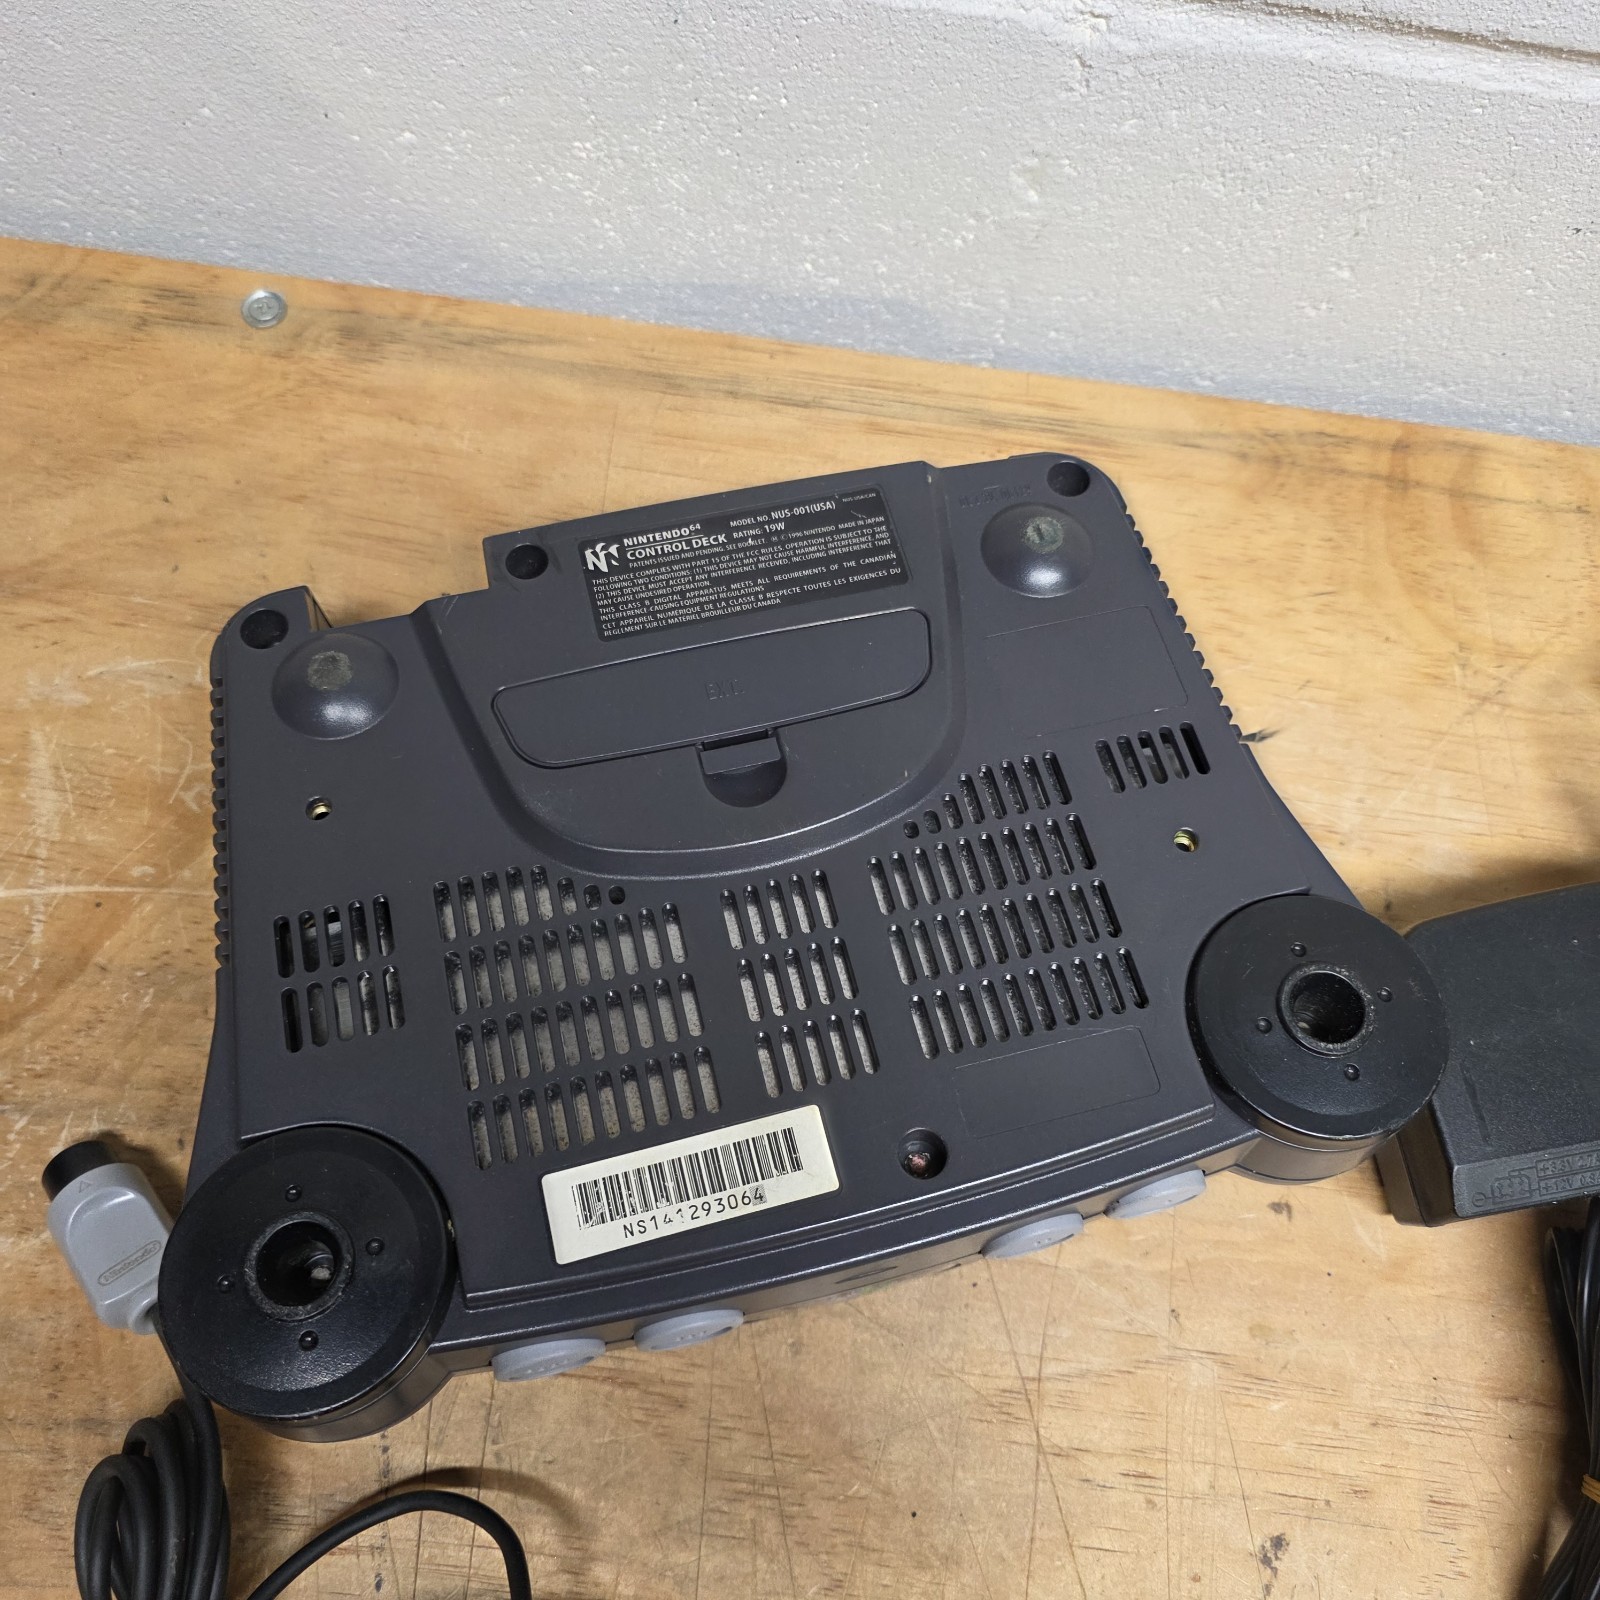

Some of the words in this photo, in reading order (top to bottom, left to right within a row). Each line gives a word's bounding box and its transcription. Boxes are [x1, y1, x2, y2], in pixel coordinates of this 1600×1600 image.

[729, 517, 755, 527] MODEL
[756, 514, 770, 522] NO.
[771, 500, 836, 520] NUS-001(USA)
[732, 527, 763, 538] RATING:
[764, 521, 785, 532] 19W
[592, 577, 608, 585] THIS
[609, 572, 634, 582] DEVICE
[635, 565, 670, 577] COMPLIES
[672, 561, 690, 570] WITH
[691, 558, 710, 566] PART
[732, 551, 745, 559] THE
[785, 536, 824, 549] OPERATION
[833, 530, 861, 540] SUBJECT
[593, 580, 632, 592] FOLLOWING
[633, 577, 649, 585] TWO
[650, 569, 692, 581] CONDITIONS:
[703, 564, 718, 572] THIS
[719, 559, 741, 569] DEVICE
[742, 556, 756, 564] MAY
[773, 549, 794, 559] CAUSE
[795, 543, 826, 554] HARMFUL
[875, 532, 889, 540] AND
[626, 540, 690, 560] CONTROL
[691, 533, 727, 548] DECK
[629, 558, 657, 568] PATENTS
[657, 554, 679, 563] ISSUED
[680, 551, 694, 559] AND
[803, 525, 835, 536] NINTENDO
[838, 521, 856, 529] MADE
[864, 515, 884, 524] JAPAN
[598, 606, 615, 614] THIS
[618, 601, 641, 610] CLASS
[653, 593, 681, 604] DIGITAL
[685, 585, 726, 598] APPARATUS
[730, 580, 753, 589] MEETS
[757, 576, 770, 584] ALL
[773, 566, 826, 581] REQUIREMENTS
[843, 560, 856, 568] THE
[860, 553, 896, 565] CANADIAN
[606, 589, 621, 597] THIS
[623, 584, 646, 594] DEVICE
[648, 580, 667, 589] MUST
[668, 575, 692, 585] ACCEPT
[694, 572, 708, 580] ANY
[710, 564, 756, 577] INTERFERENCE
[791, 550, 826, 562] INCLUDING
[827, 542, 872, 555] INTERFERENCE
[874, 538, 891, 546] THAT
[597, 598, 612, 606] MAY
[613, 594, 634, 603] CAUSE
[635, 587, 672, 599] UNDESIRED
[602, 621, 616, 629] CET
[619, 614, 654, 626] APPAREIL
[728, 595, 755, 605] CLASSE
[765, 586, 801, 598] RESPECTE
[803, 580, 831, 591] TOUTES
[833, 577, 846, 585] LES
[849, 570, 887, 582] EXIGENCES
[644, 620, 658, 628] SUR
[700, 605, 741, 618] BROUILLEUR
[752, 597, 781, 608] CANADA
[680, 594, 718, 606] EQUIPMENT
[719, 585, 764, 598] REGULATIONS
